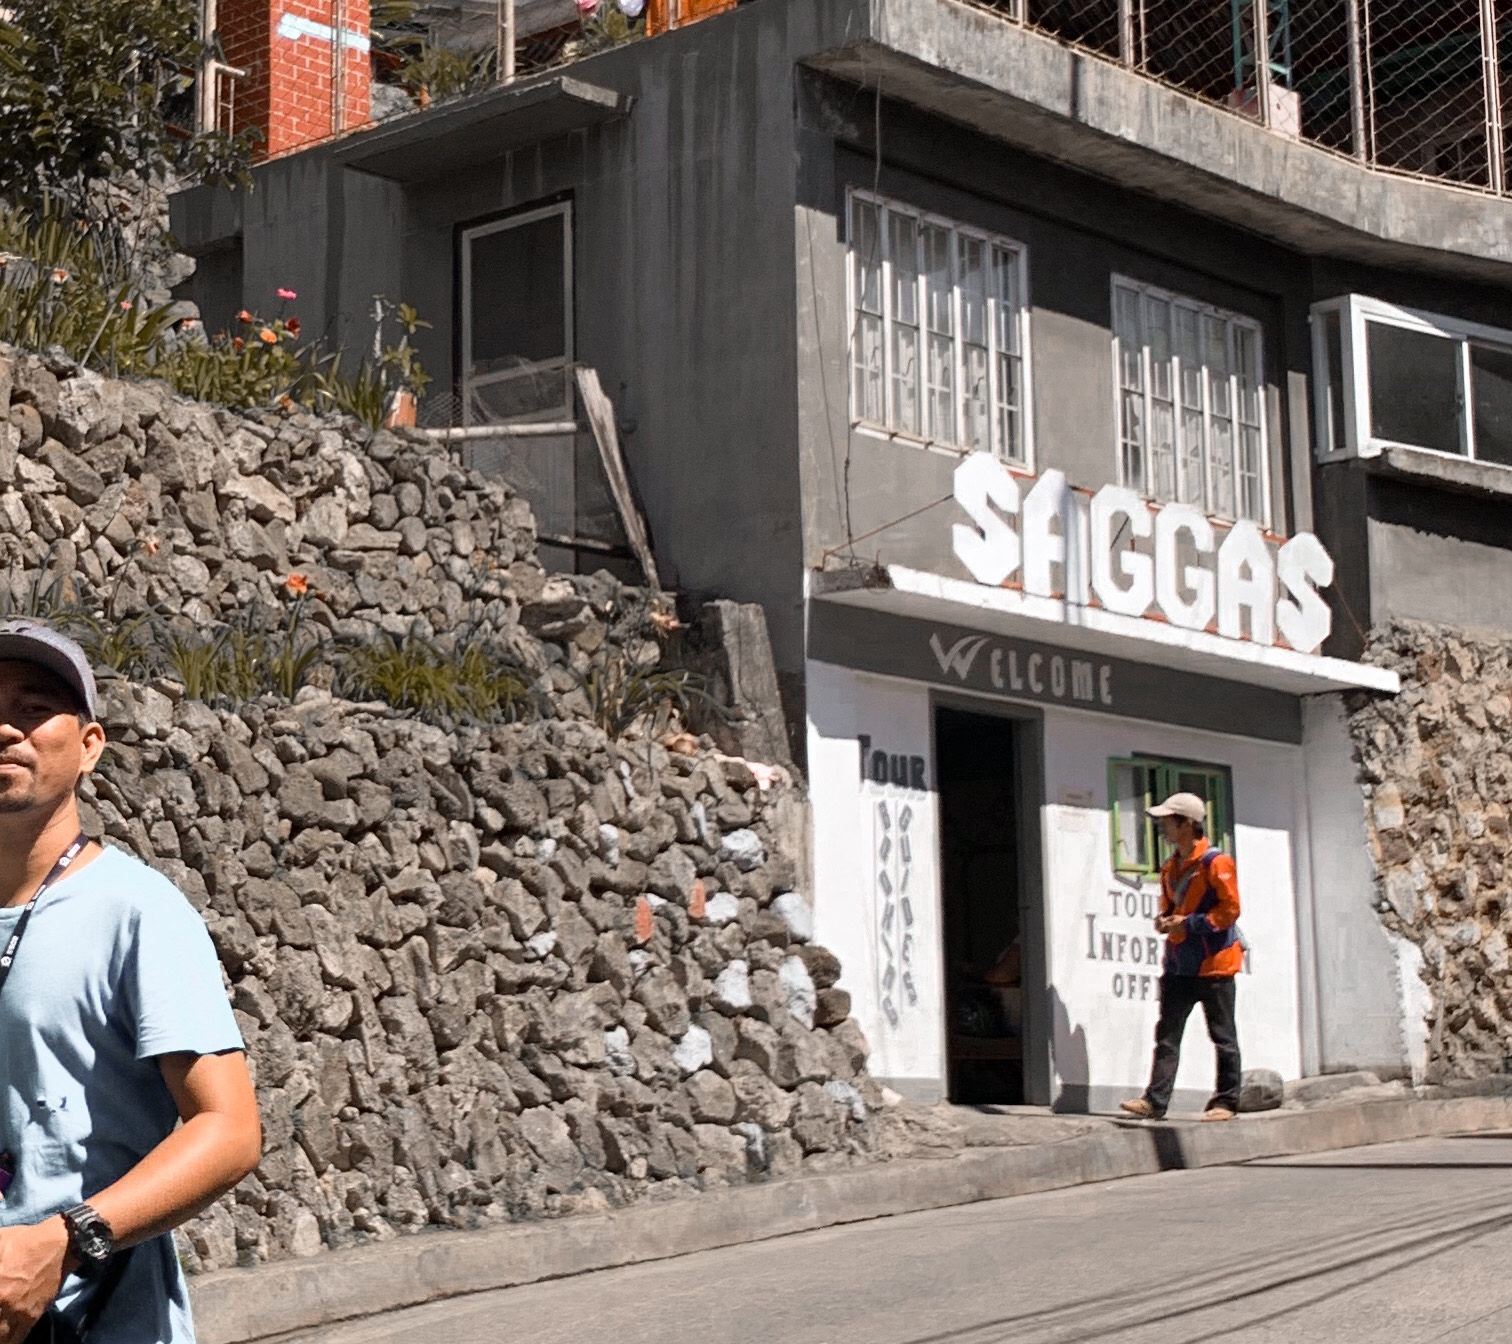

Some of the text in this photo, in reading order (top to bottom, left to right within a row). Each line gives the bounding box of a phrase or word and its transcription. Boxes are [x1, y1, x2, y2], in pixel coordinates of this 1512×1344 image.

[952, 452, 1335, 654] SAGGAS
[929, 632, 1113, 705] WELCOME
[857, 734, 929, 797] TOUR
